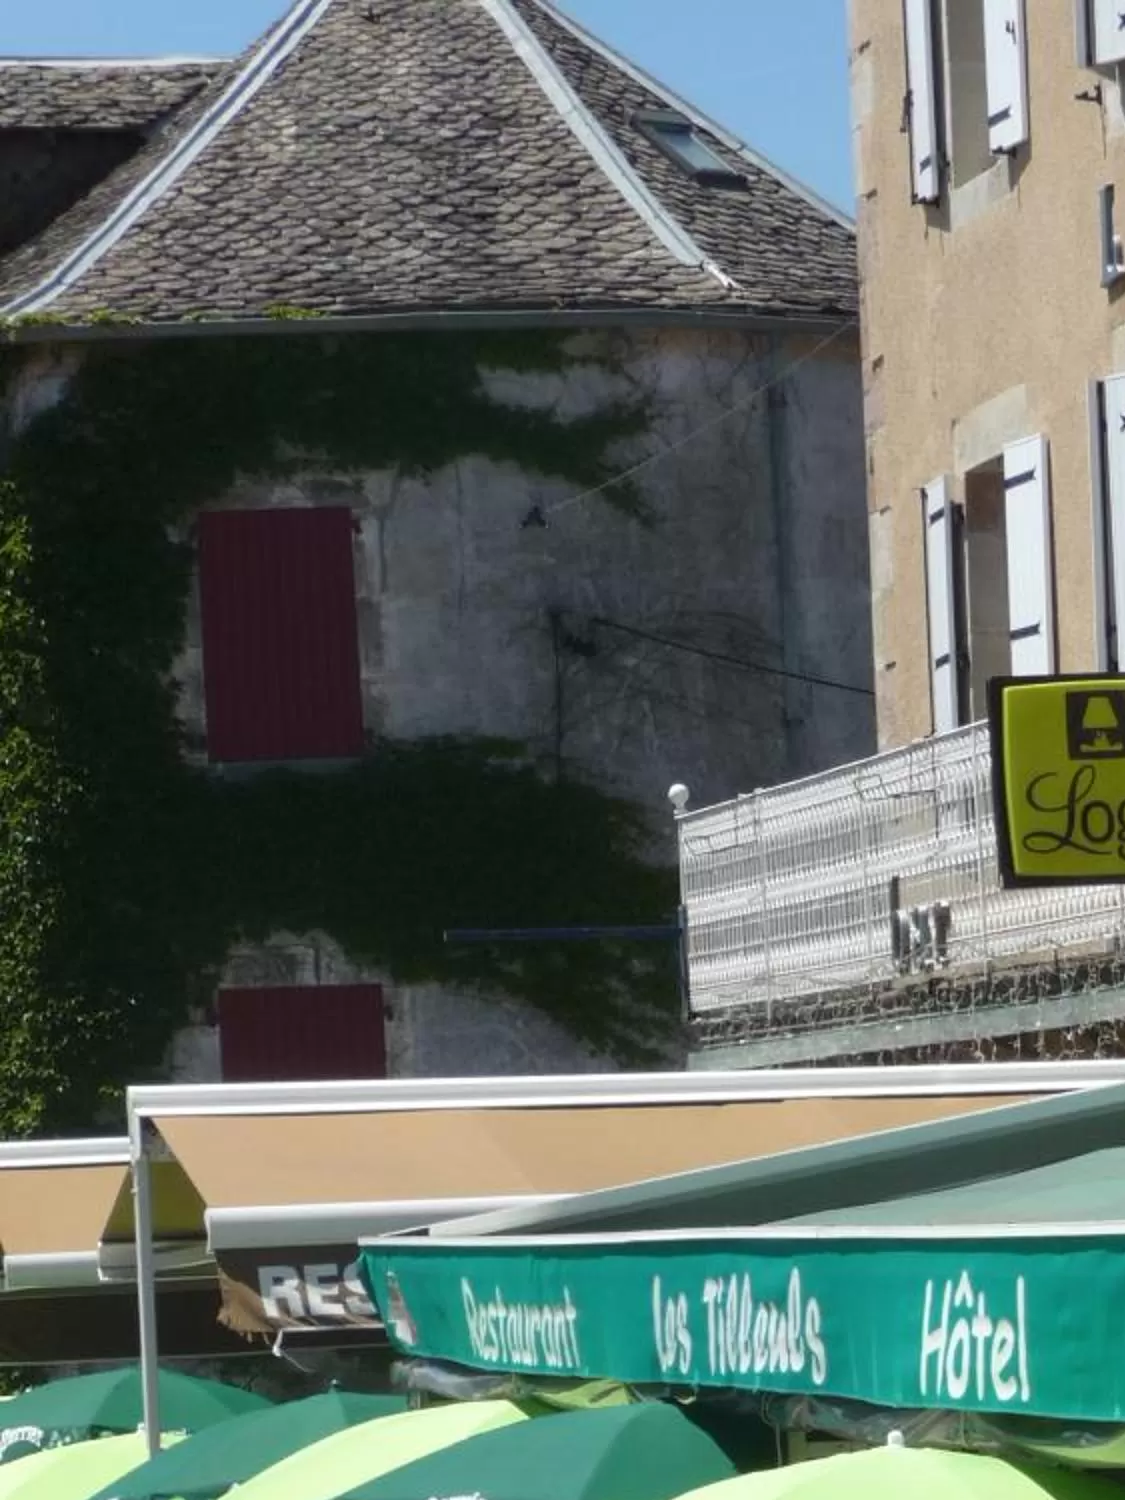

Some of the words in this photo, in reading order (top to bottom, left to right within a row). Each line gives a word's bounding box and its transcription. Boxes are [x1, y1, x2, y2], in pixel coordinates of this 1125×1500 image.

[460, 1276, 581, 1369] Restaurant
[651, 1274, 693, 1376] Les
[702, 1265, 827, 1386] Tilleuls
[919, 1267, 1031, 1403] Hôtel
